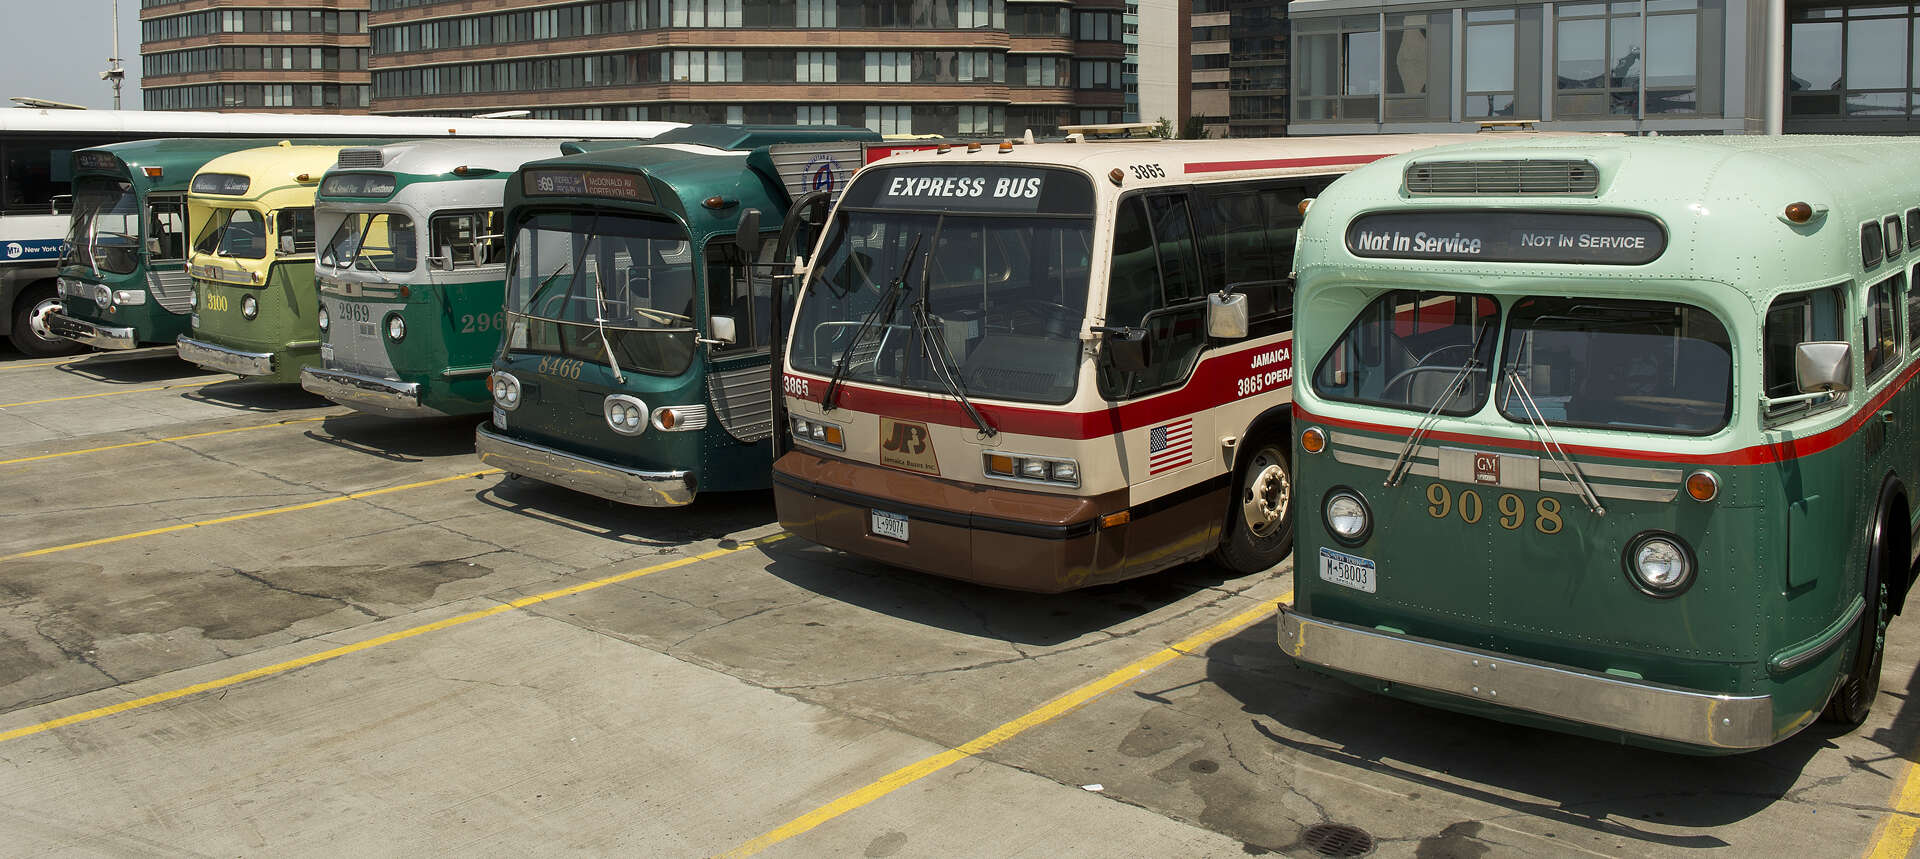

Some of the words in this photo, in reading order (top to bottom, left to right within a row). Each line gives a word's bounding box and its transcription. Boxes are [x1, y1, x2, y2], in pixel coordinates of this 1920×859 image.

[1129, 163, 1166, 180] 3865
[888, 177, 985, 197] EXPRESS
[993, 177, 1041, 199] BUS
[1358, 231, 1391, 251] Not
[1392, 231, 1410, 251] In
[1412, 231, 1482, 254] Service
[207, 293, 228, 312] 3100
[339, 303, 370, 322] 2969
[538, 353, 584, 380] 8466
[1250, 347, 1290, 369] JAMAICA
[783, 375, 809, 397] 3865
[1237, 373, 1263, 396] 3865
[1477, 457, 1496, 472] GM
[1425, 482, 1564, 535] 9098
